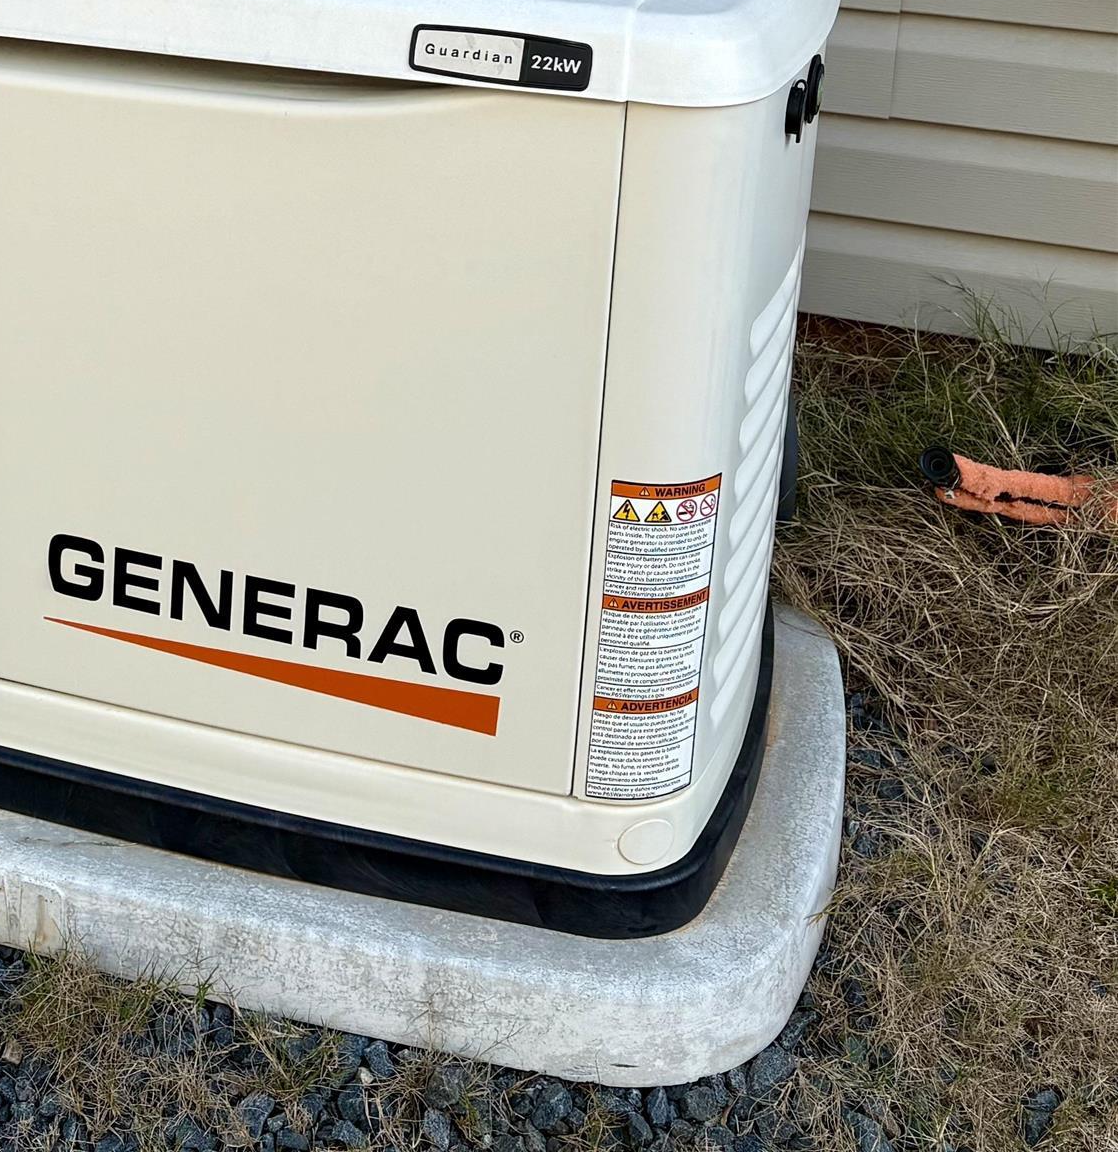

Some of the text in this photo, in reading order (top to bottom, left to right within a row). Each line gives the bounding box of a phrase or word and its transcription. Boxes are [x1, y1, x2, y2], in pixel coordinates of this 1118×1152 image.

[424, 43, 582, 75] Guardian 22kW
[655, 483, 706, 497] WARNING
[609, 544, 634, 552] operated
[608, 553, 635, 562] Explosion
[622, 591, 706, 610] AVERTISSEMENT
[601, 638, 628, 646] personnel
[621, 693, 693, 711] ADVERTENCIA
[602, 739, 626, 747] personal
